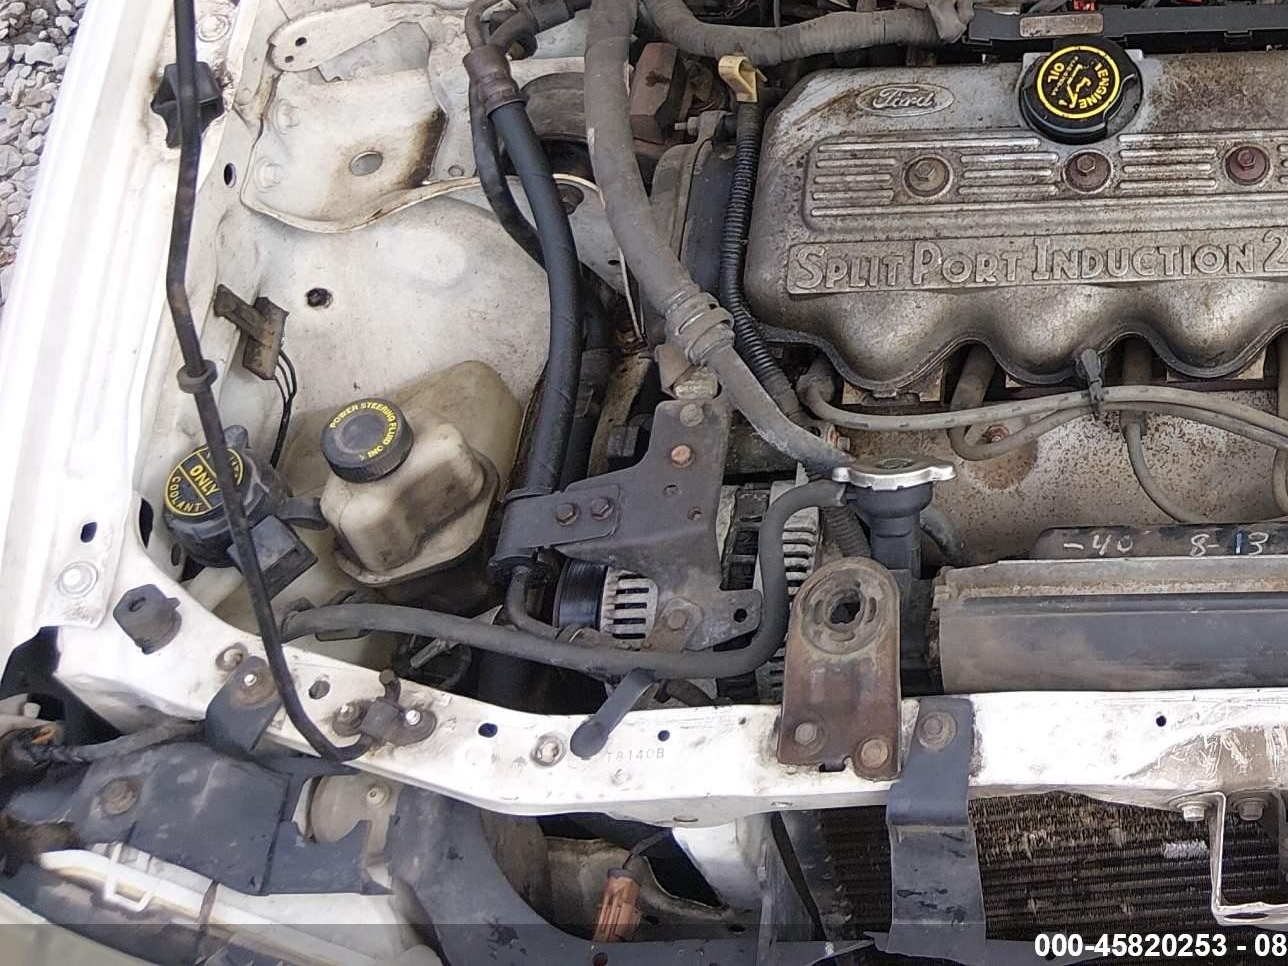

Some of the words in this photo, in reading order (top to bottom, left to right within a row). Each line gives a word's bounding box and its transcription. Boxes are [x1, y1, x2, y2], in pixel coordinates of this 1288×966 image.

[1047, 62, 1065, 83] OIL
[1078, 67, 1110, 109] ENGINE
[872, 87, 935, 109] Ford
[793, 244, 905, 290] SPLIT
[912, 239, 1024, 285] PORT
[1032, 237, 1255, 281] INDUCTION
[329, 404, 359, 429] POWER
[360, 401, 397, 422] STEERING
[382, 422, 398, 446] FLUID
[169, 475, 203, 513] COOLANT
[190, 464, 221, 497] ONLY
